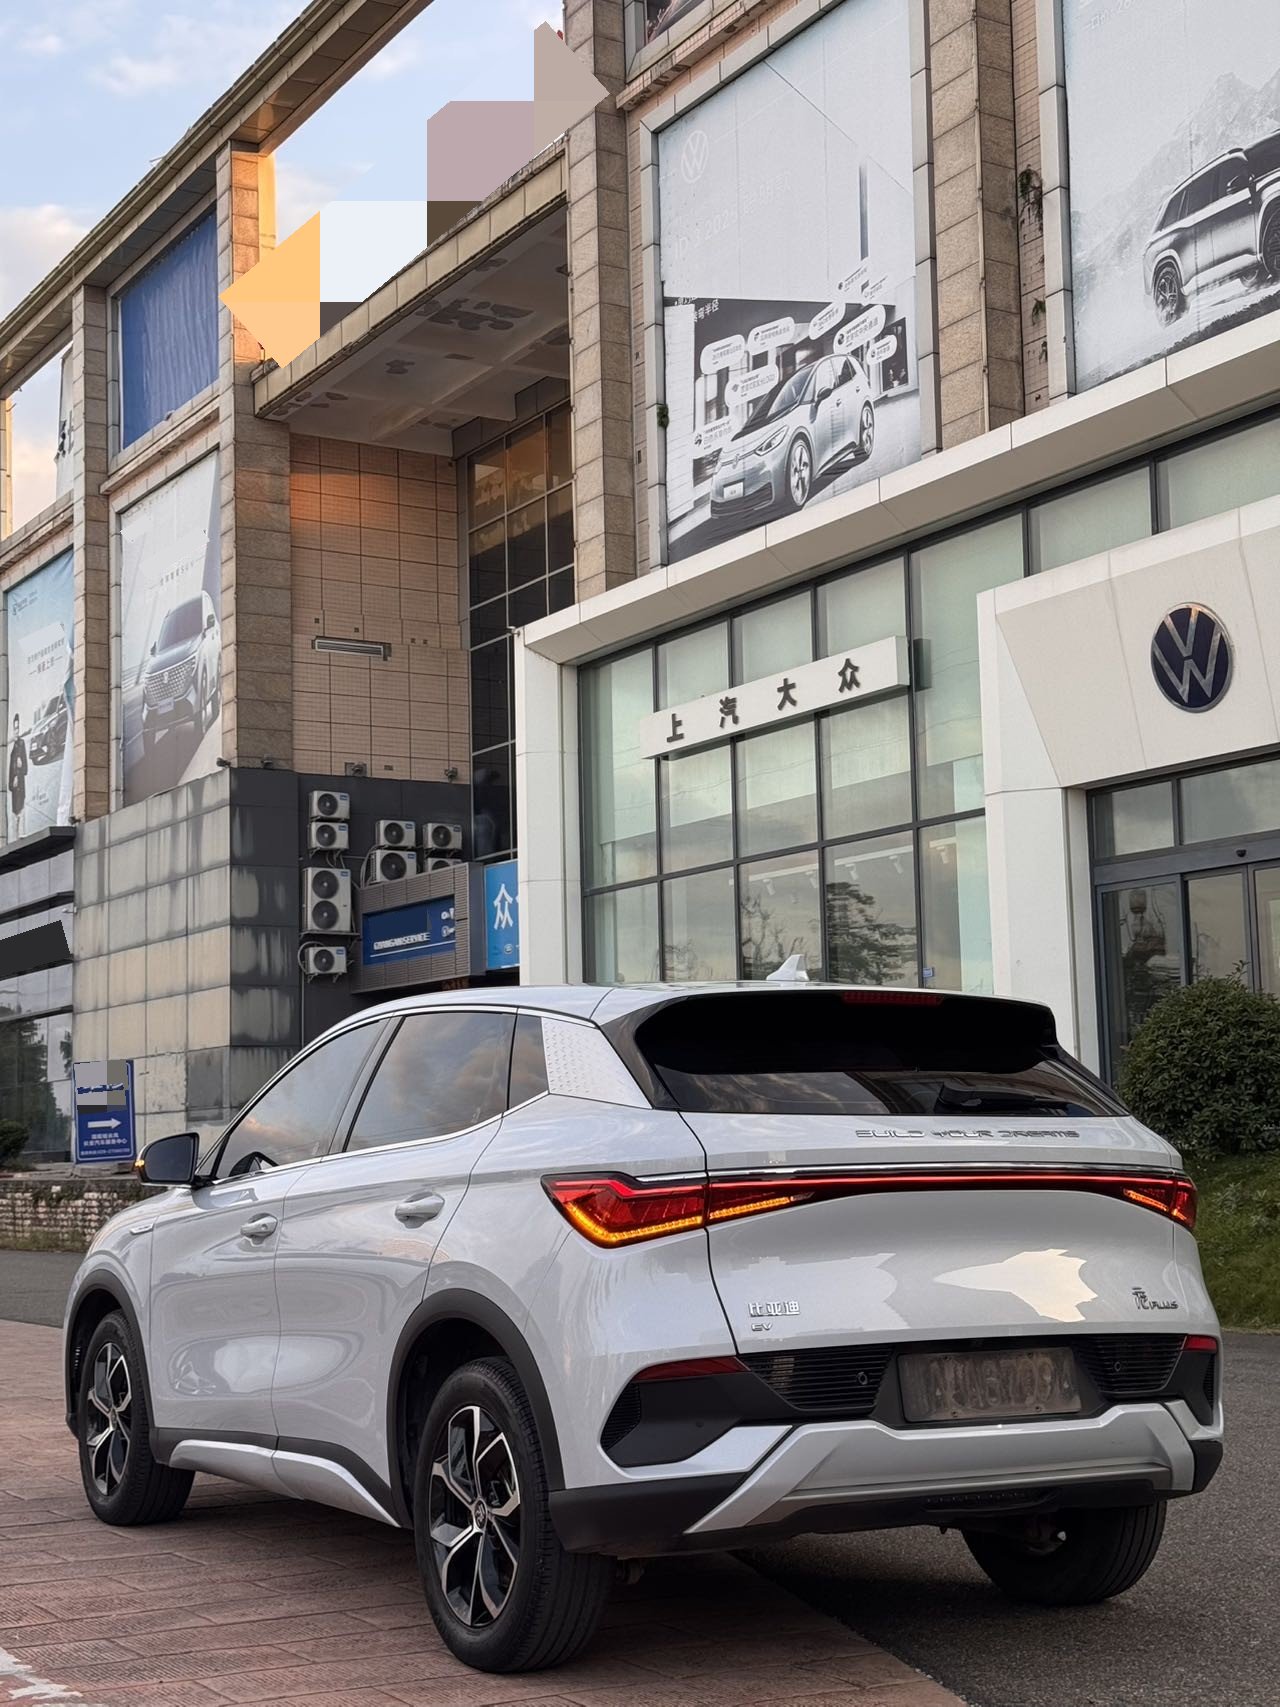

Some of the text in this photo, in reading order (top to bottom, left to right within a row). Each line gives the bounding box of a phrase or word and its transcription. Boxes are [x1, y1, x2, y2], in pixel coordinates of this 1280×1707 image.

[666, 657, 862, 743] 上汽大众
[493, 883, 519, 930] 众
[931, 1129, 994, 1138] YOUR
[998, 1130, 1081, 1138] DREAMS
[748, 1300, 800, 1317] 比亚迪
[751, 1322, 773, 1331] EV
